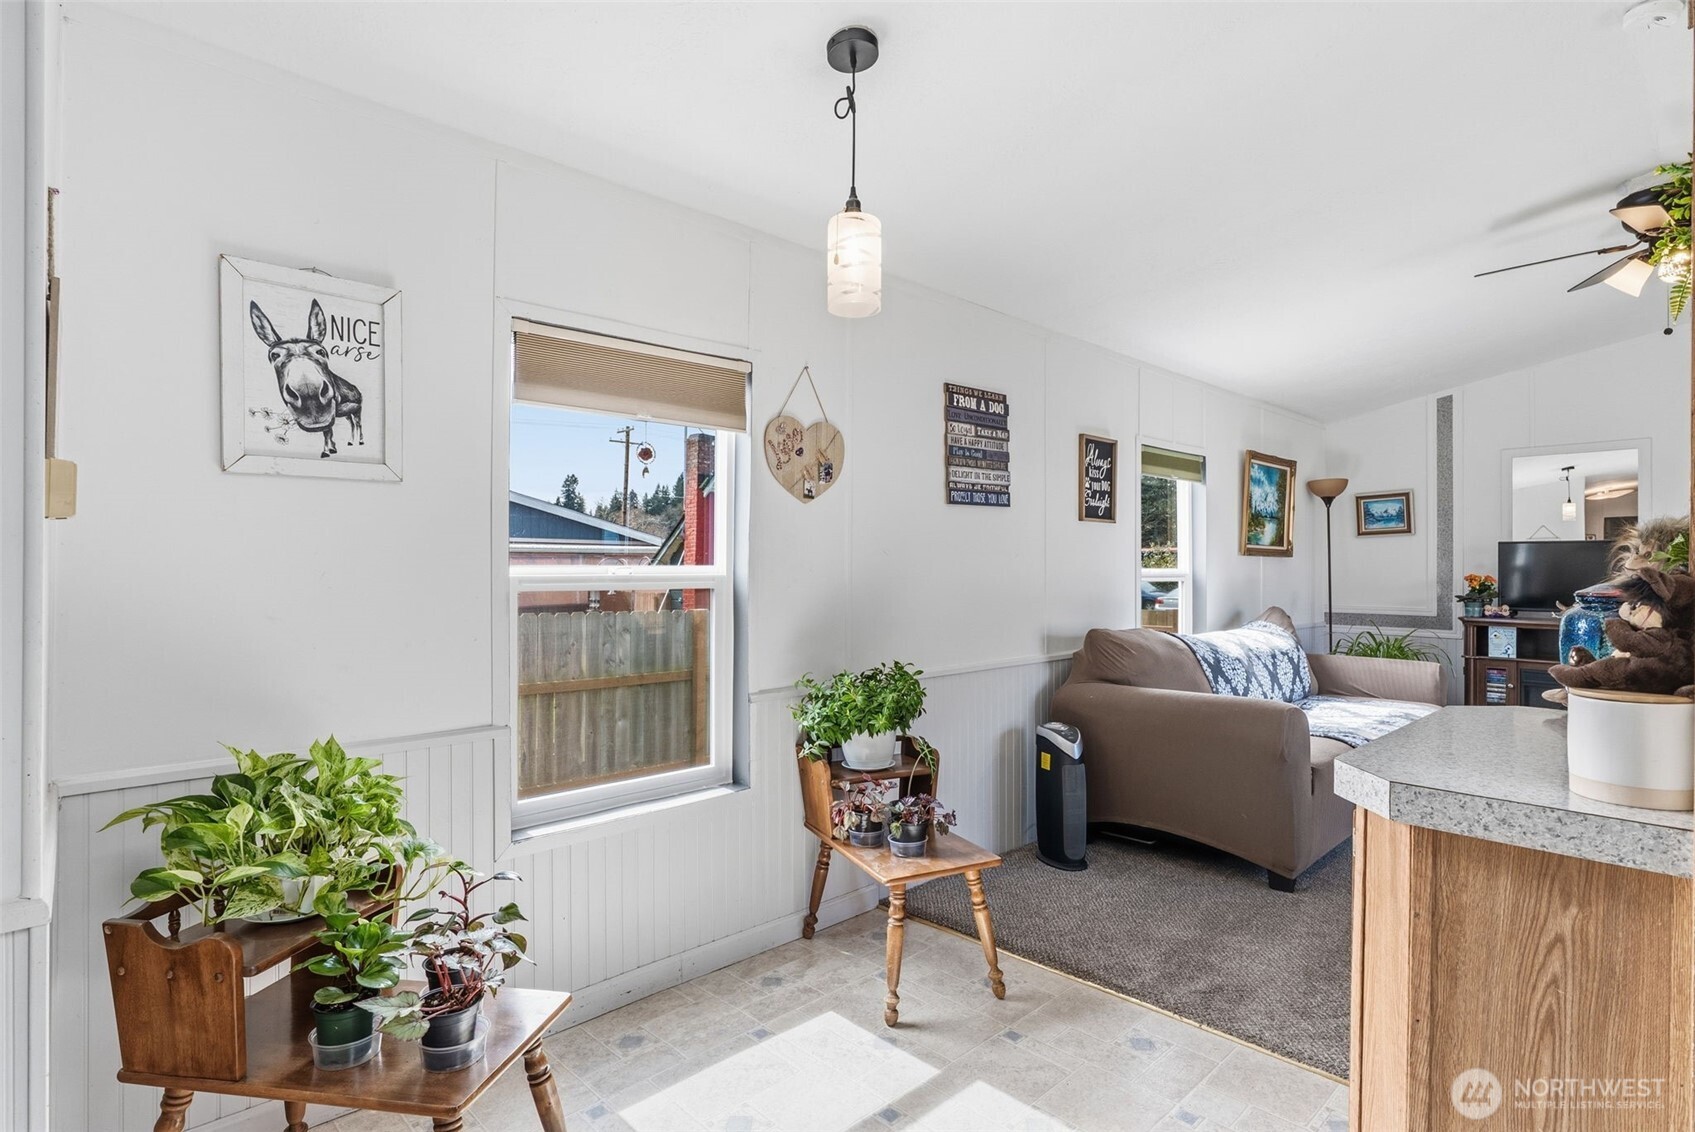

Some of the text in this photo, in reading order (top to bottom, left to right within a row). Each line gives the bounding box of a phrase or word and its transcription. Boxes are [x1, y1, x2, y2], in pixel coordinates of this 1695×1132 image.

[331, 315, 380, 347] NICE
[330, 344, 381, 362] arse
[949, 385, 972, 395] THINGS
[953, 395, 1004, 414] FROM A DOG
[951, 437, 963, 446] HAVE
[968, 440, 983, 448] HAPPY
[984, 441, 1004, 450] ATTITUDE
[1086, 444, 1111, 478] Always
[952, 470, 973, 479] DELIGHT
[982, 472, 991, 481] THE
[993, 474, 1010, 482] SIMPLE
[1089, 466, 1099, 478] kiss
[1092, 481, 1110, 491] your DOG
[951, 491, 1008, 504] PROTECT THOSE YOU LOVE
